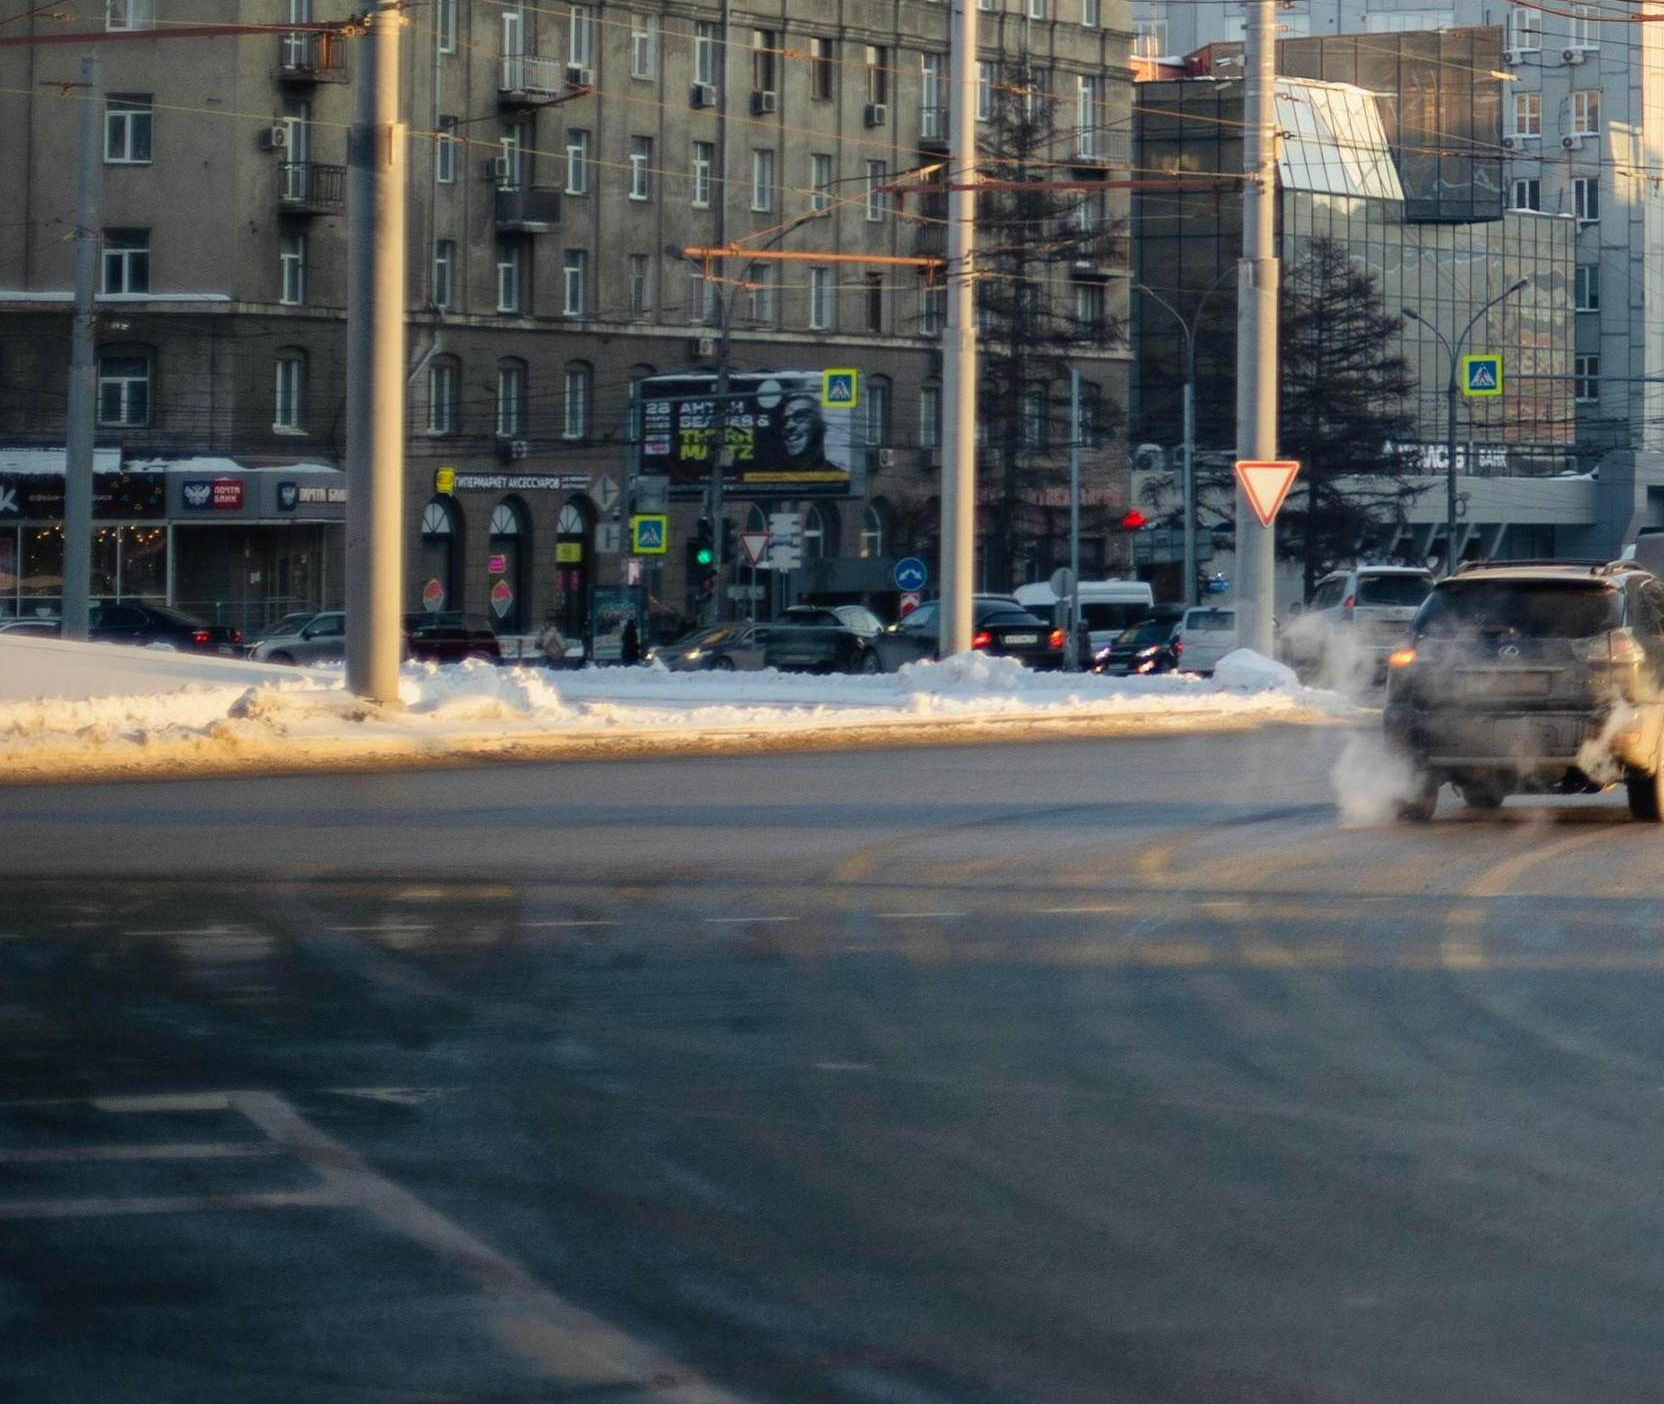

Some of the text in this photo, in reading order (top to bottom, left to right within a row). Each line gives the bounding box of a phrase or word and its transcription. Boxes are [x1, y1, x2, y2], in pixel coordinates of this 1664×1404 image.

[645, 402, 671, 414] 28
[214, 486, 241, 495] ПОЧТА
[214, 495, 238, 503] БАНК
